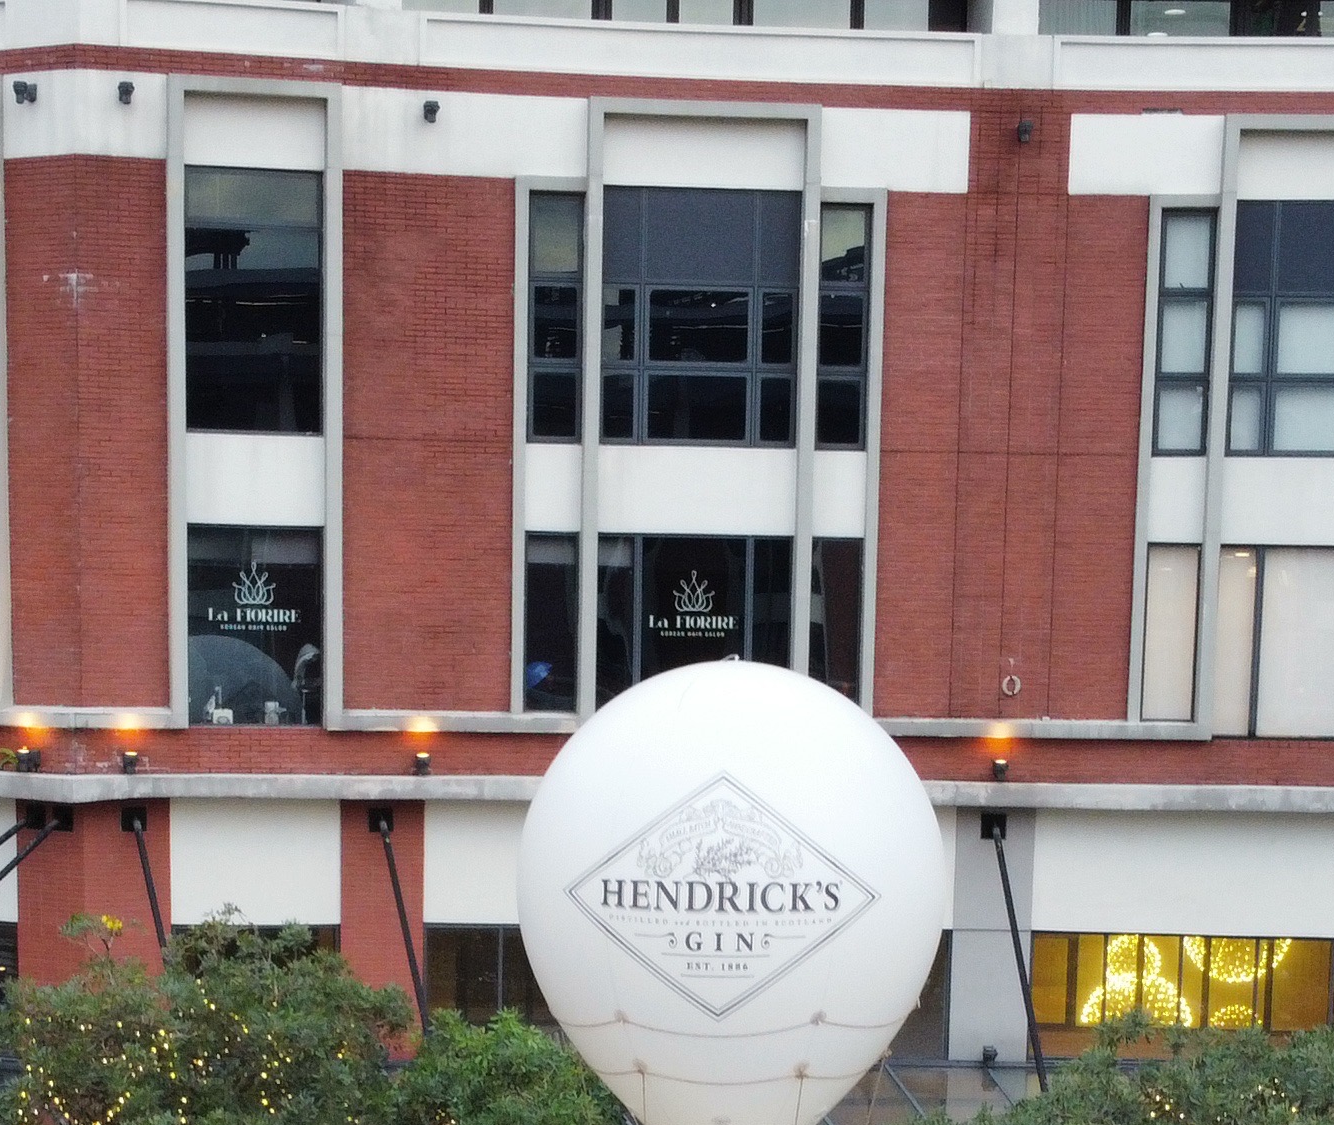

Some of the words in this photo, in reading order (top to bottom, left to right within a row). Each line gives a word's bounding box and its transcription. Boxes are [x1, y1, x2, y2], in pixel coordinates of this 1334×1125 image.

[208, 607, 228, 621] La
[649, 614, 668, 628] La
[601, 878, 841, 914] HENDRICK'S
[684, 931, 755, 952] GIN
